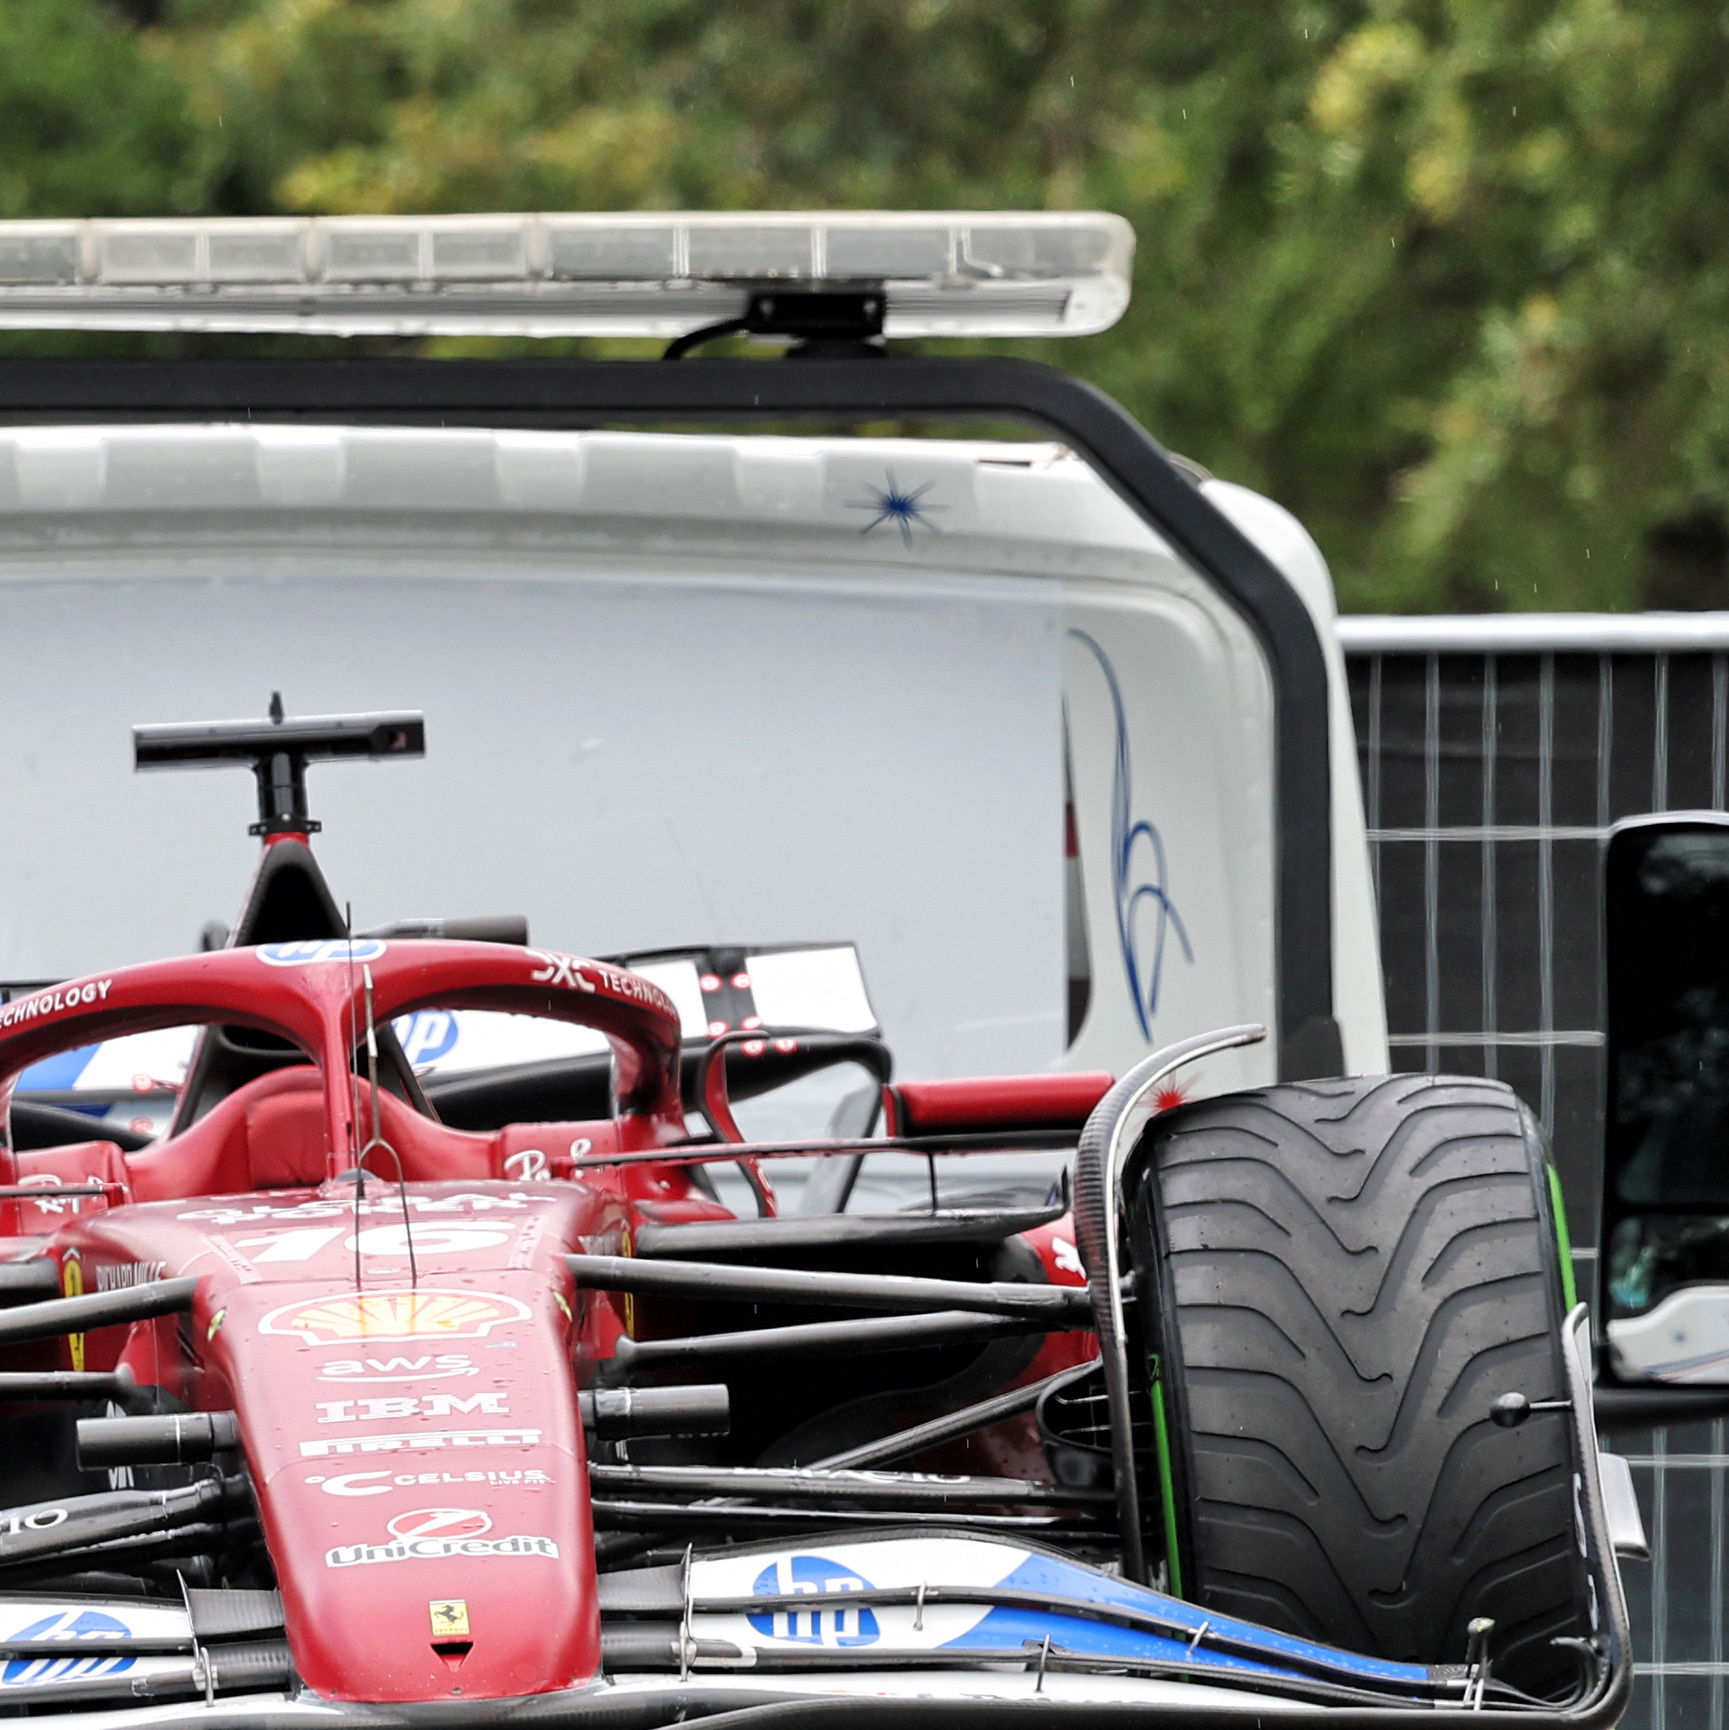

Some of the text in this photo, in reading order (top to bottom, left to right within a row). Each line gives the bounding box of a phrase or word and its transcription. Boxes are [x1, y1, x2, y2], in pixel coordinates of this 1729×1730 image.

[598, 969, 678, 1019] TECHNOL
[236, 1219, 516, 1264] 16
[320, 1354, 475, 1378] aws
[315, 1392, 510, 1424] IBM
[299, 1428, 543, 1457] PIRELLI
[394, 1469, 549, 1486] CELSIUS
[328, 1536, 557, 1566] UniCredit
